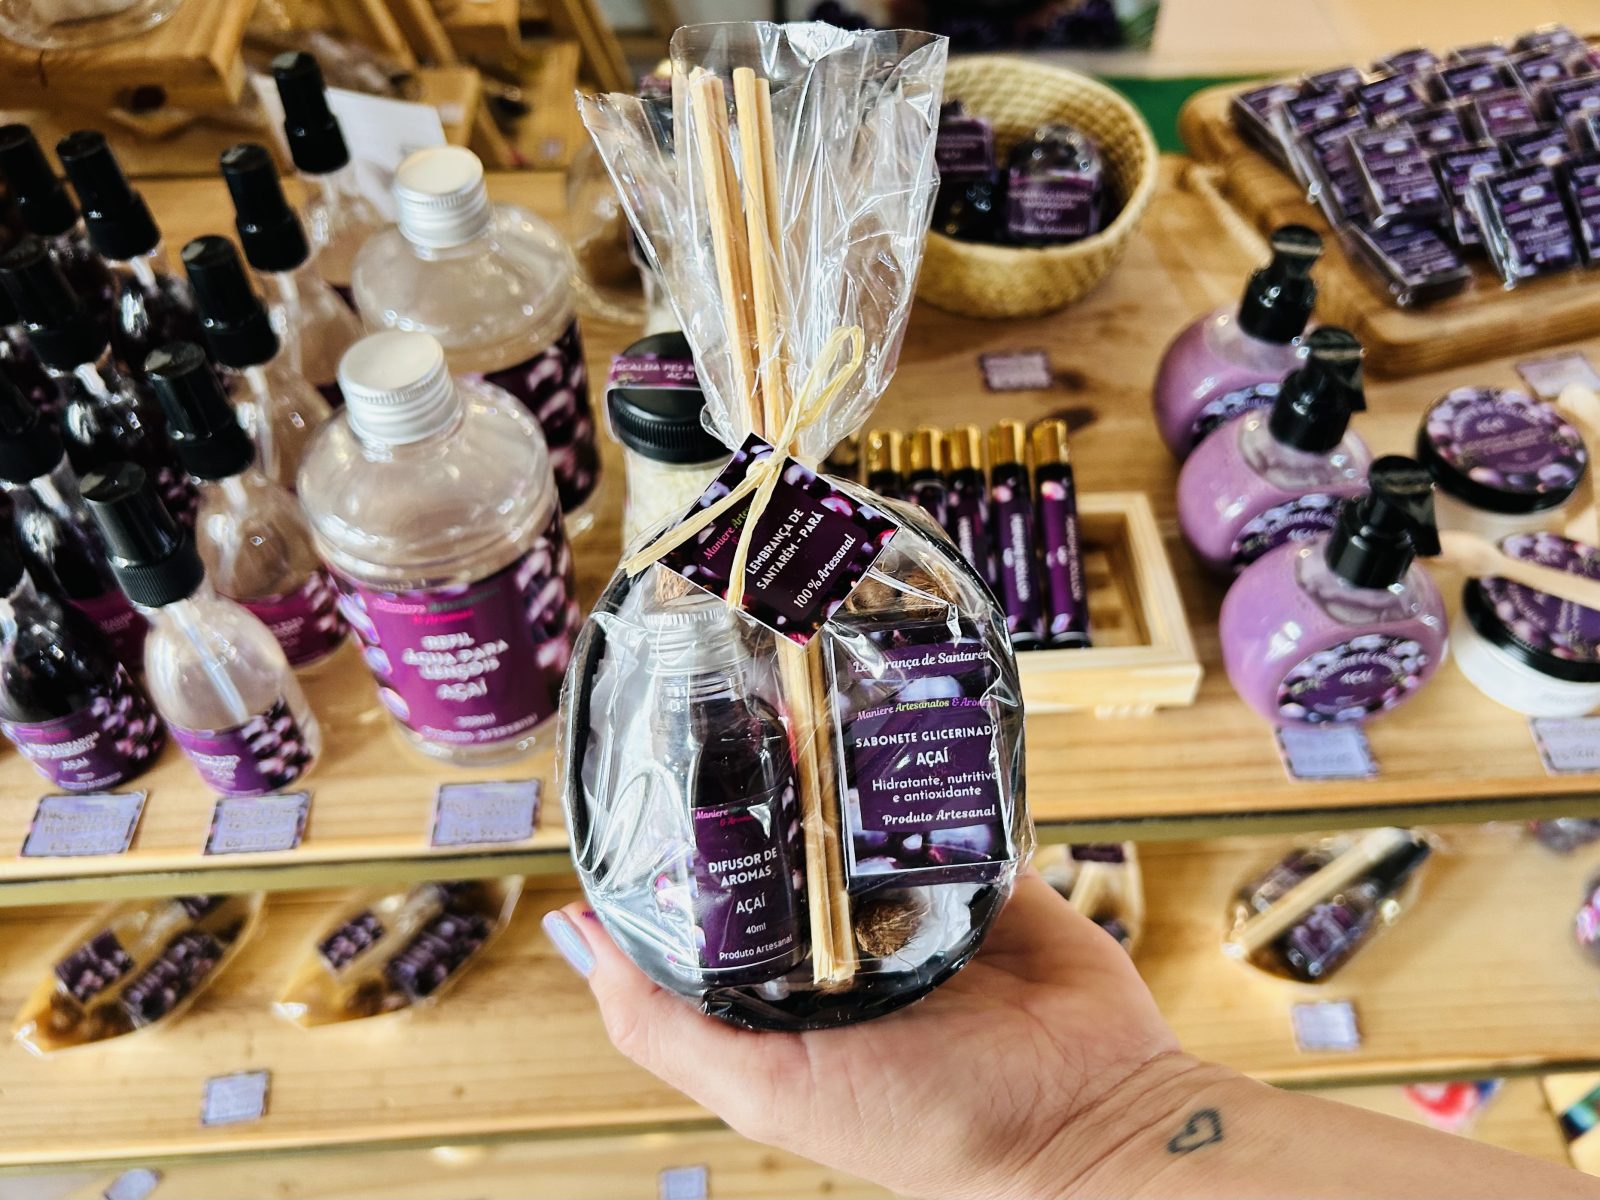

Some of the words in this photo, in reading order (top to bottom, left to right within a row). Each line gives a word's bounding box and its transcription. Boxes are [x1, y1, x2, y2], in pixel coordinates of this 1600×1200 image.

[704, 526, 736, 560] Maniere
[746, 525, 791, 575] LEMBRANÇA
[788, 508, 804, 524] DE
[757, 542, 799, 590] SANTARÉM
[800, 510, 825, 538] PARÁ
[793, 589, 812, 609] 100
[818, 533, 857, 582] Artesanal
[853, 658, 920, 673] Lerança
[922, 653, 936, 666] de
[436, 676, 488, 702] AÇAÍ
[857, 706, 894, 721] Maniere
[895, 699, 949, 712] Artesanatos
[952, 697, 960, 707] &
[855, 730, 918, 748] SABONETE
[922, 724, 998, 741] GLICERINADO
[916, 747, 949, 768] AÇAÍ
[872, 776, 944, 791] Hidratante,
[893, 794, 899, 803] e
[904, 785, 981, 802] antioxidante
[695, 808, 728, 820] Maniere
[882, 814, 932, 826] Produto
[936, 804, 996, 820] Artesanal
[708, 853, 761, 874] DIFUSOR
[764, 847, 778, 859] DE
[720, 865, 772, 887] AROMAS
[735, 892, 766, 914] AÇAÍ
[745, 922, 766, 934] 40ml
[719, 948, 755, 961] Produto
[756, 934, 792, 954] Artesanal
